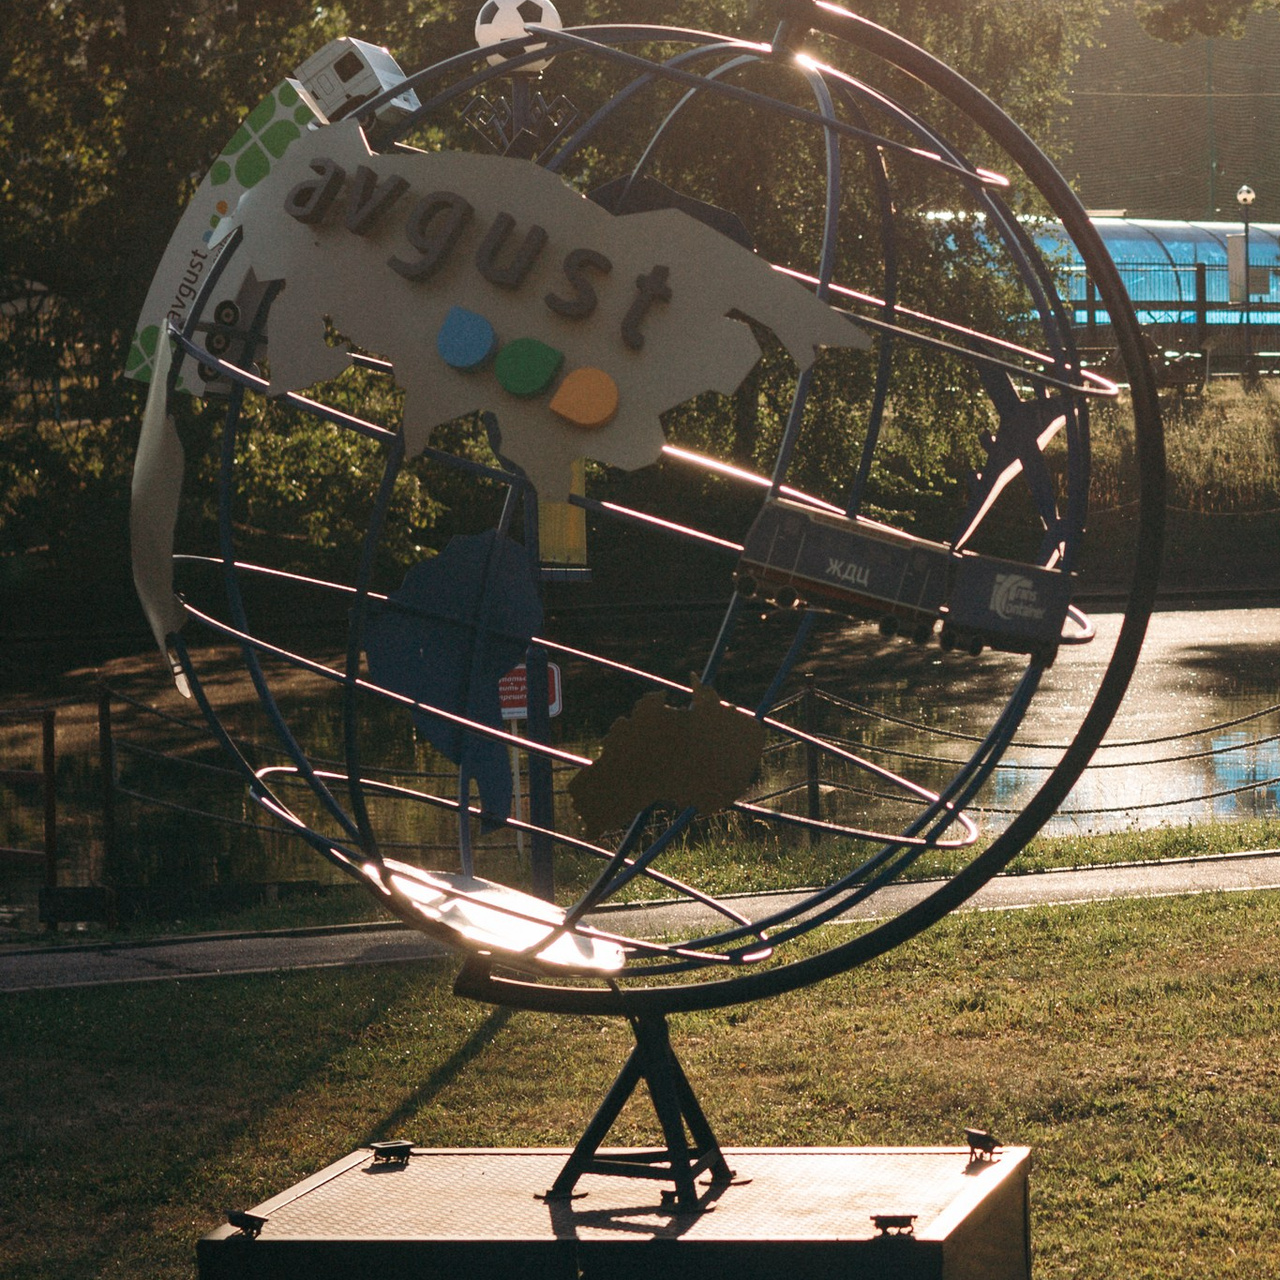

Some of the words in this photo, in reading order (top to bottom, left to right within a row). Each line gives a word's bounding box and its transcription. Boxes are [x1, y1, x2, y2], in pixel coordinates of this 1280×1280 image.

[167, 248, 208, 322] avgust
[284, 157, 674, 352] avgust
[825, 557, 871, 587] ЖДЦ
